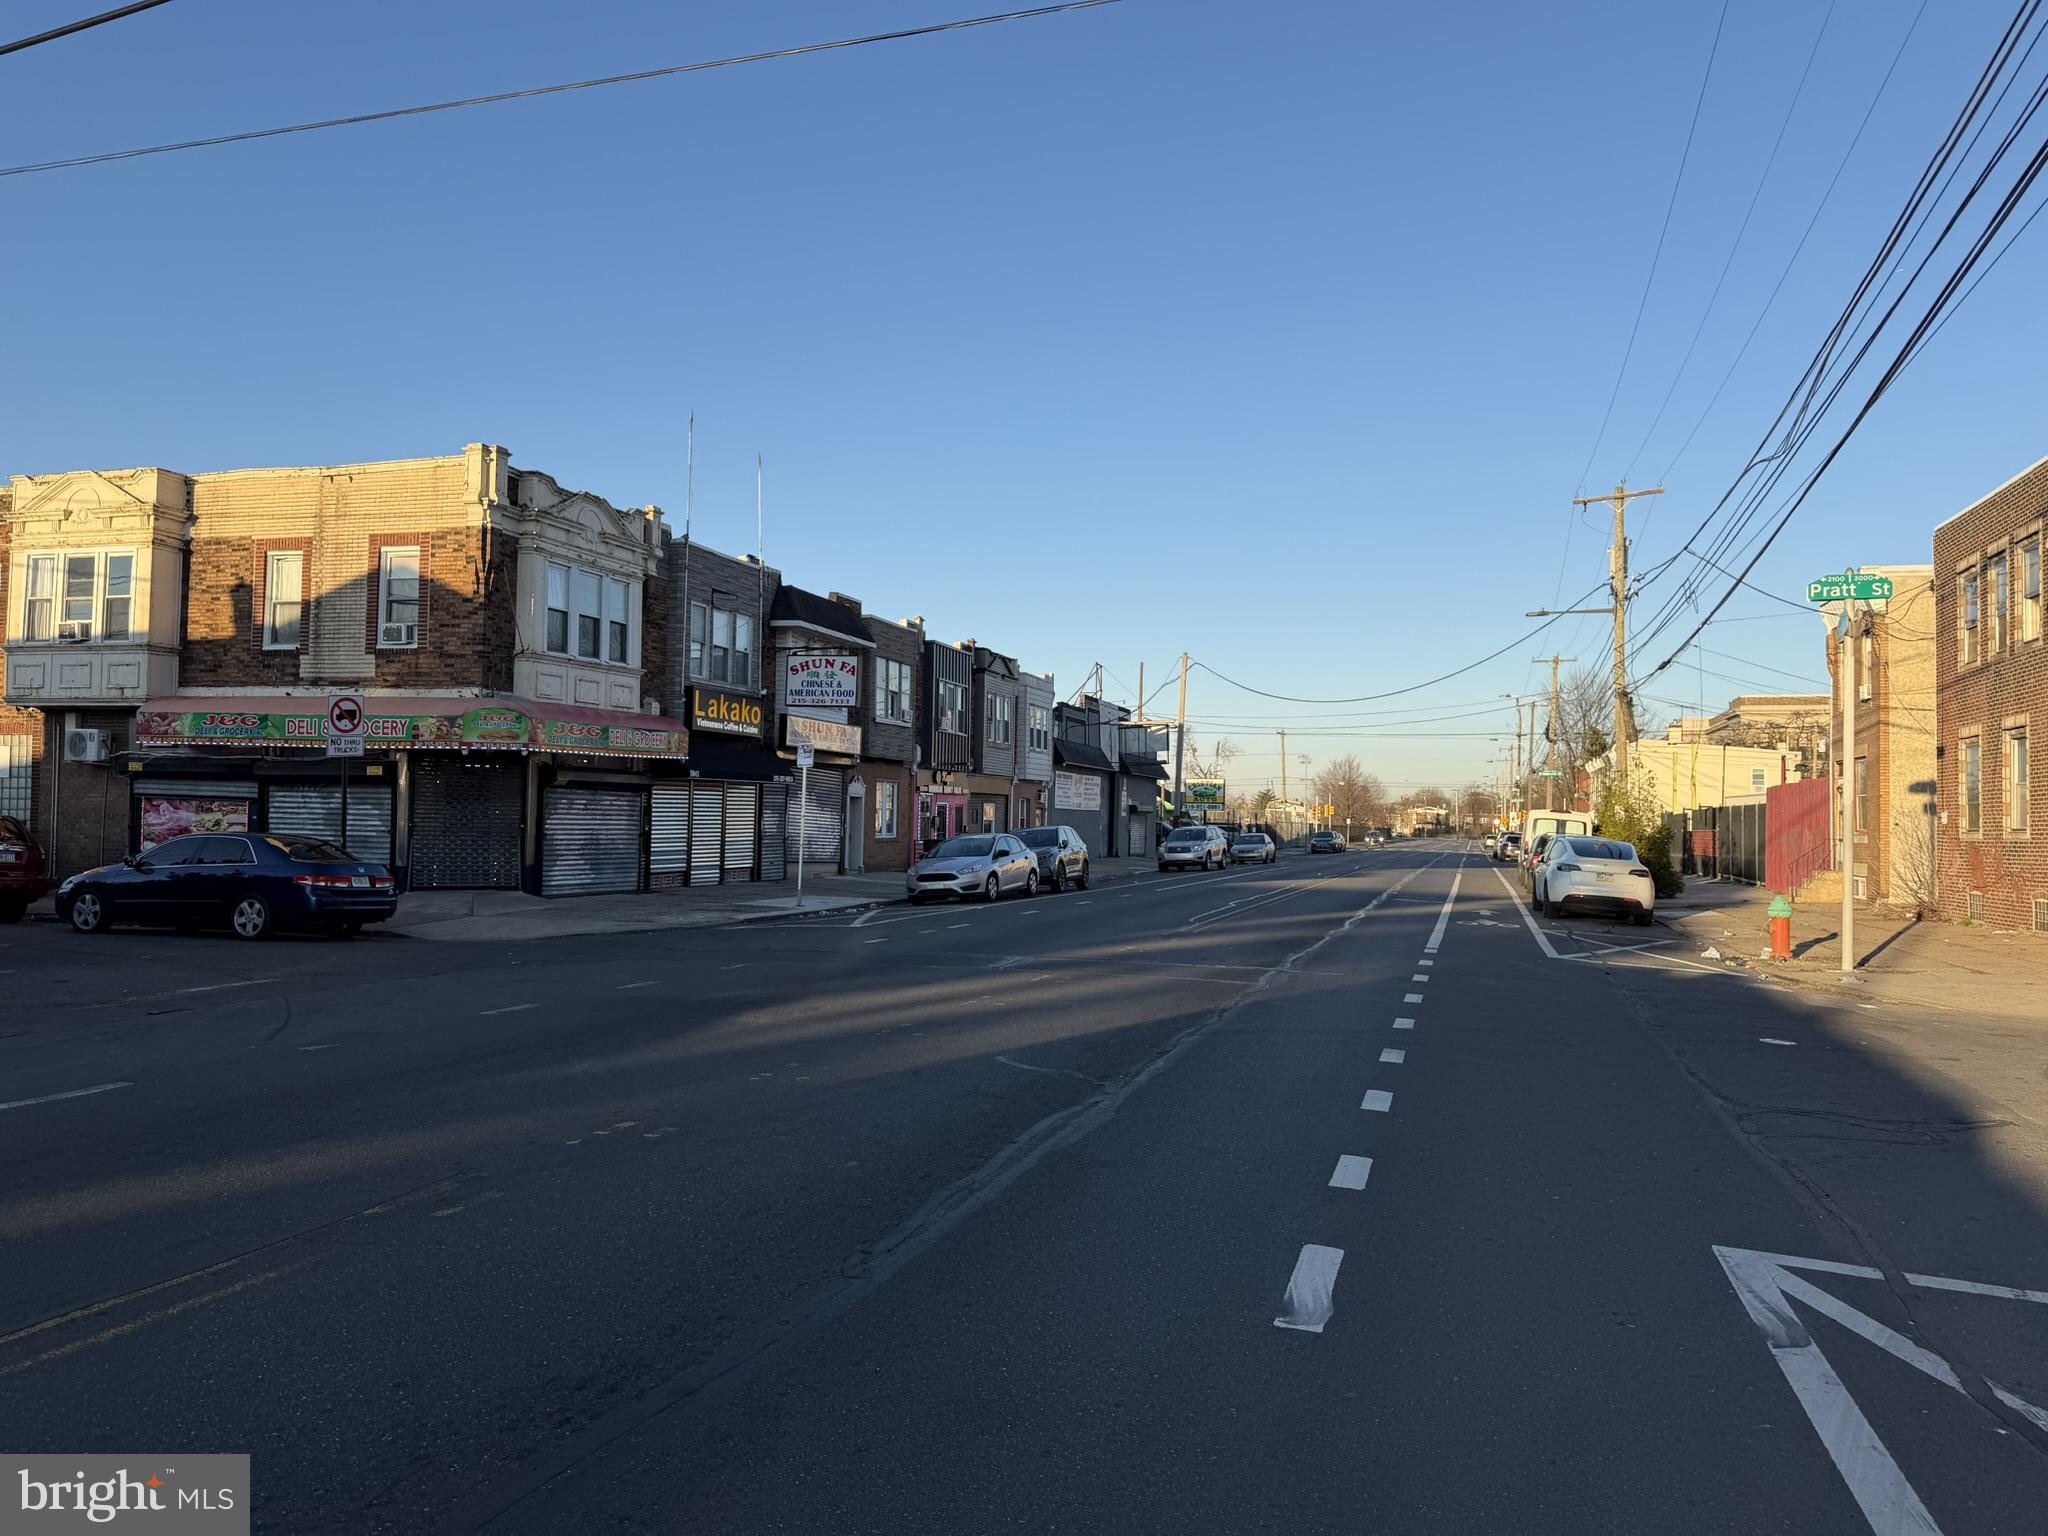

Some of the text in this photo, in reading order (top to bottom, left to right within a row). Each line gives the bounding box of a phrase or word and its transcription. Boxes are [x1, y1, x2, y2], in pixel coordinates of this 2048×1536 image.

[1810, 582, 1890, 597] Pratt St
[790, 658, 856, 676] SHUN FA
[801, 680, 842, 688] CHINESE &
[788, 689, 854, 698] AMERICAN FOOD
[695, 689, 761, 725] Lakako
[201, 714, 260, 728] J&G
[286, 718, 318, 736] DELI
[696, 717, 723, 730] Vietnamese
[724, 721, 738, 731] Coffee
[195, 727, 211, 735] DELI
[213, 727, 219, 735] &
[219, 727, 253, 736] GROCERY
[802, 720, 849, 737] SHUN FA
[330, 738, 361, 747] NO THRU
[548, 735, 563, 743] DELI
[569, 737, 597, 746] GROCERY
[609, 729, 627, 746] DELI
